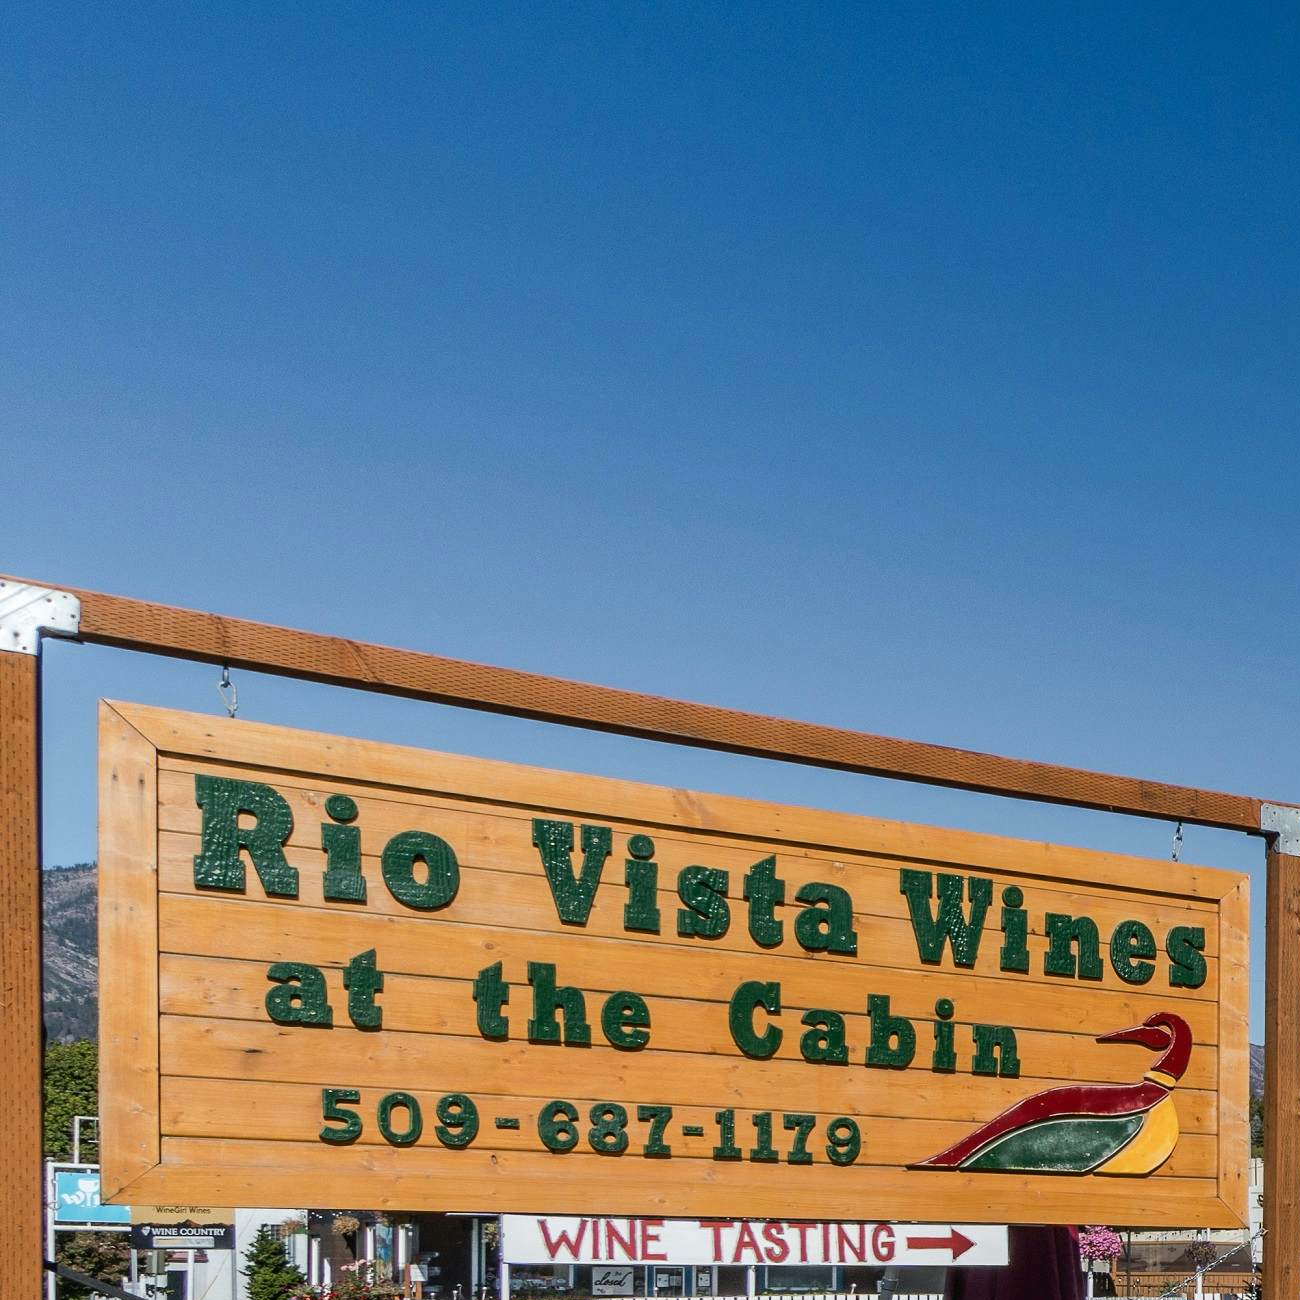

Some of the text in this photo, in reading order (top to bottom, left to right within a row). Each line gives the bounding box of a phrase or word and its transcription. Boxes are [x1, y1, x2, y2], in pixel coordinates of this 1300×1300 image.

[193, 773, 1208, 988] Rio Vista Wines
[265, 948, 1020, 1078] at the Cabin
[319, 1088, 861, 1166] 509-687-1179
[180, 1228, 226, 1236] COUNTRY
[537, 1218, 897, 1263] WINE TASTING
